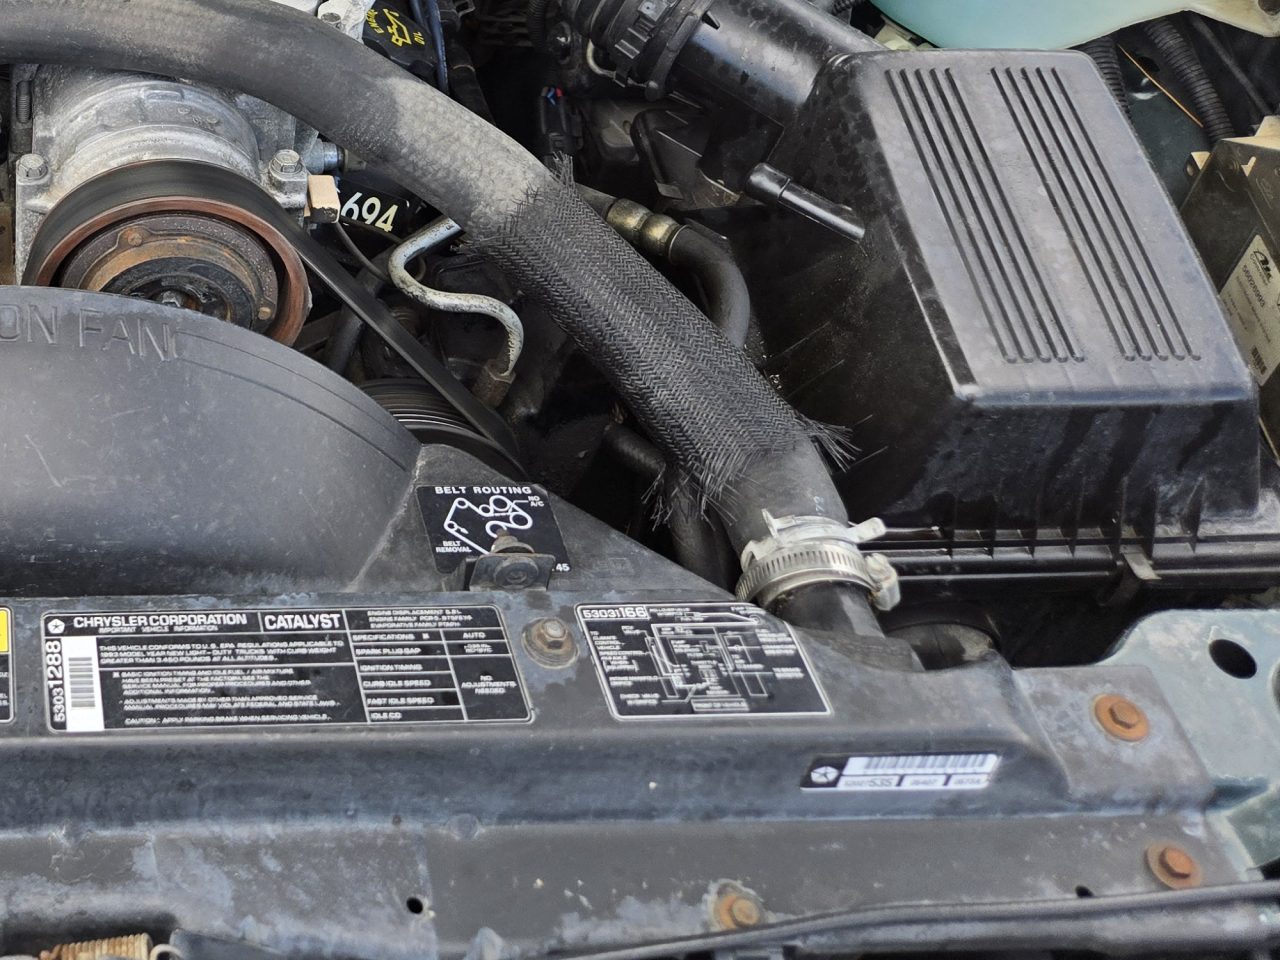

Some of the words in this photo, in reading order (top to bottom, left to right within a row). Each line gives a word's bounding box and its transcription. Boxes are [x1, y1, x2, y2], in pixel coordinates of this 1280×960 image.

[79, 308, 169, 361] FAN
[73, 615, 148, 627] CHRYSLER
[149, 614, 248, 626] CORPORATION
[582, 607, 646, 618] 53031166
[264, 613, 341, 630] CATALYST
[46, 641, 66, 722] 53031288
